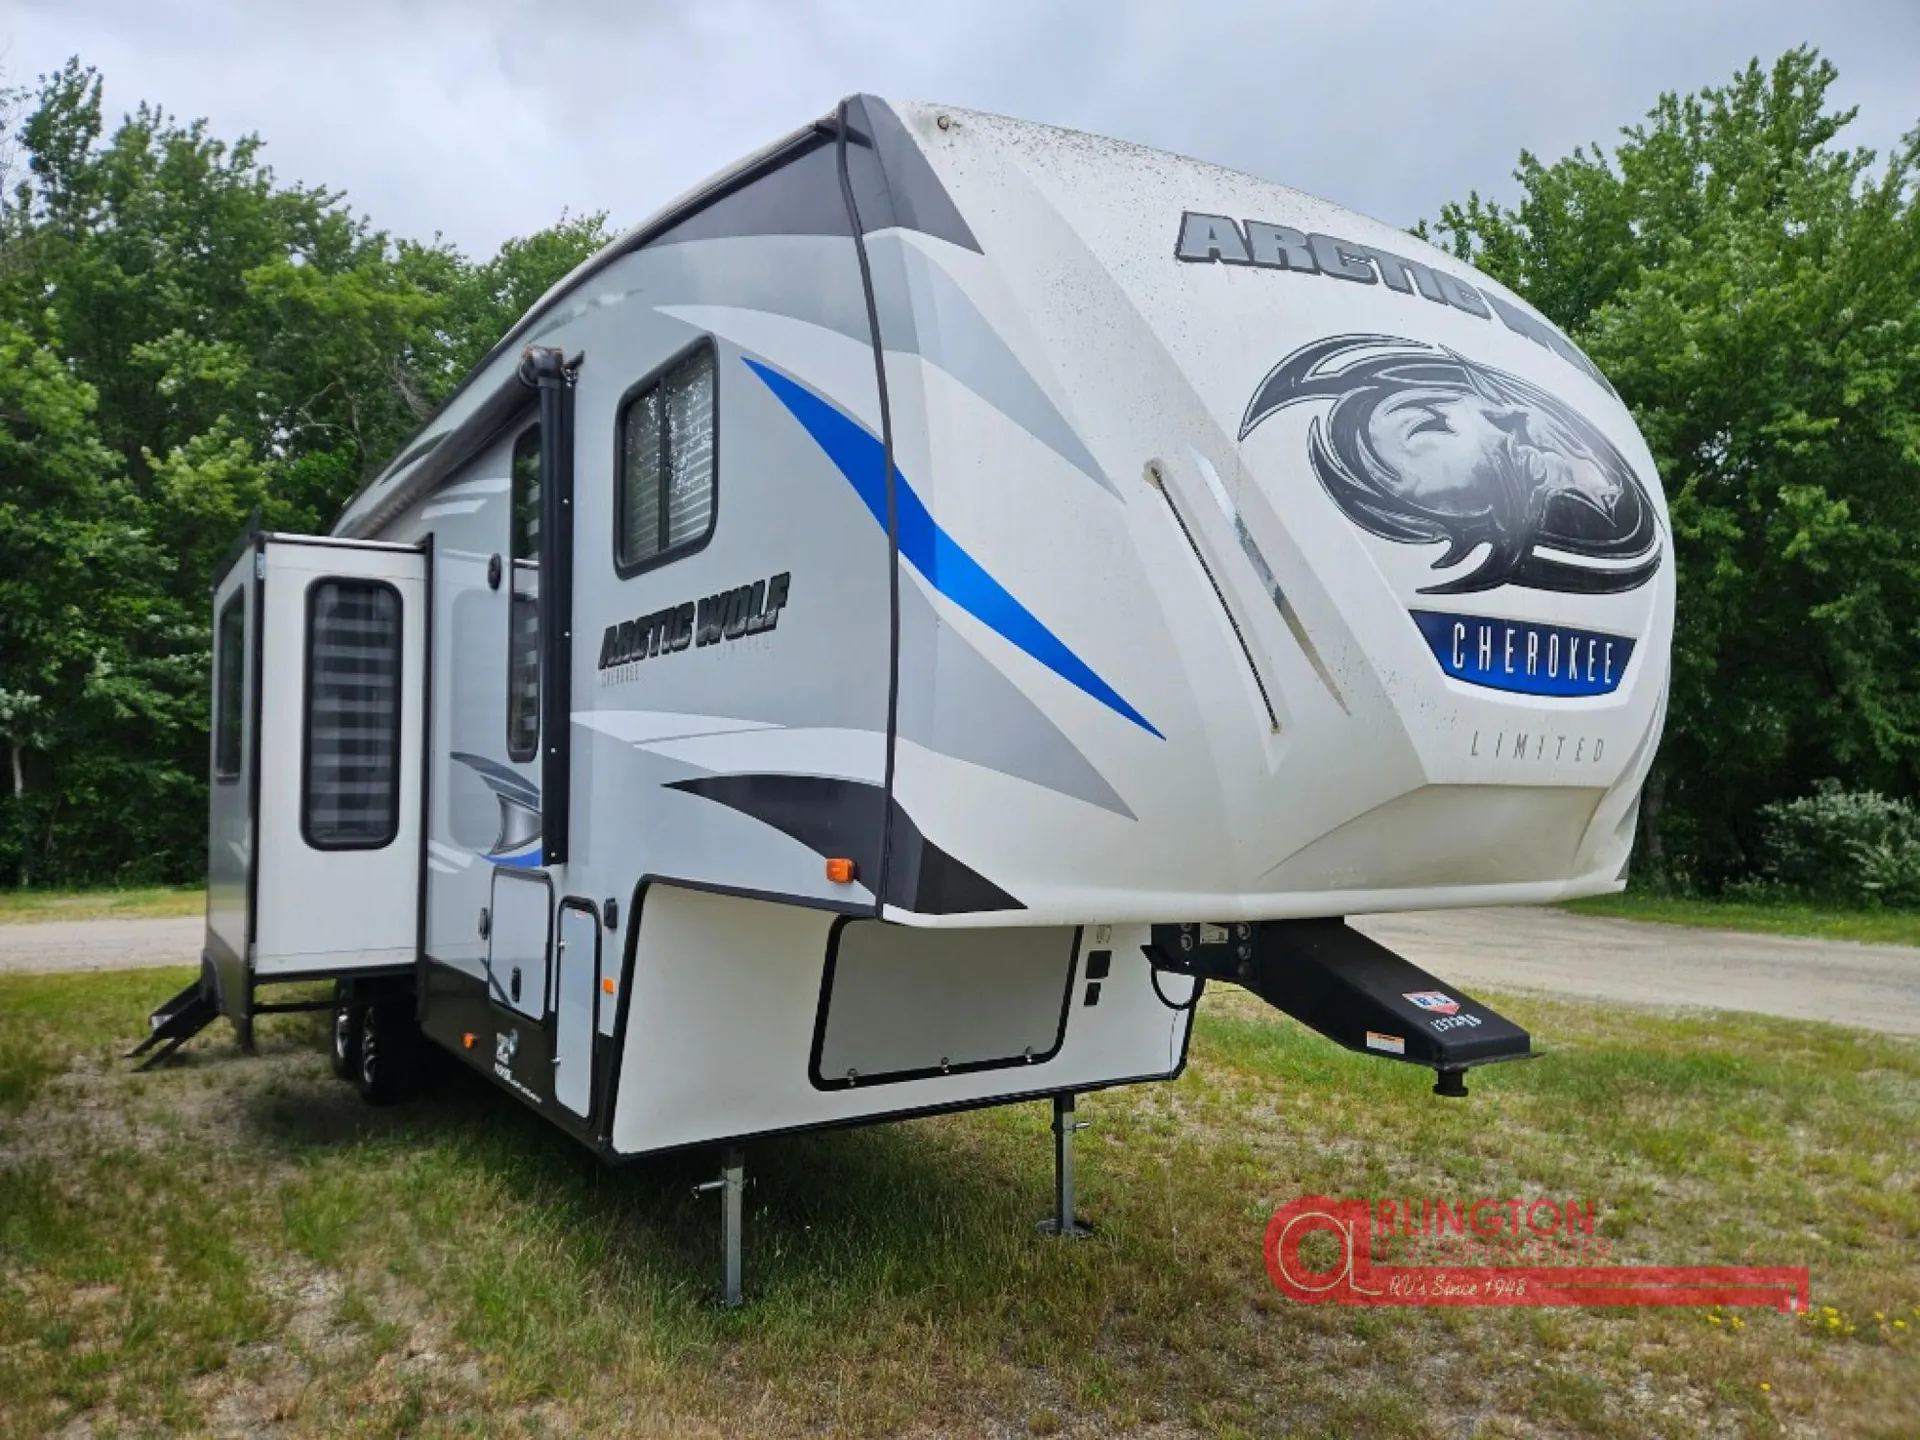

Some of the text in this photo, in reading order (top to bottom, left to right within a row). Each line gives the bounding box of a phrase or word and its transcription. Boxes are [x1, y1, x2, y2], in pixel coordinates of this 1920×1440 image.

[1175, 211, 1492, 321] ARCTIC
[598, 571, 791, 670] ARCTIC WOLF
[1452, 622, 1614, 684] CHEROKEE
[1470, 729, 1605, 763] LIMITED
